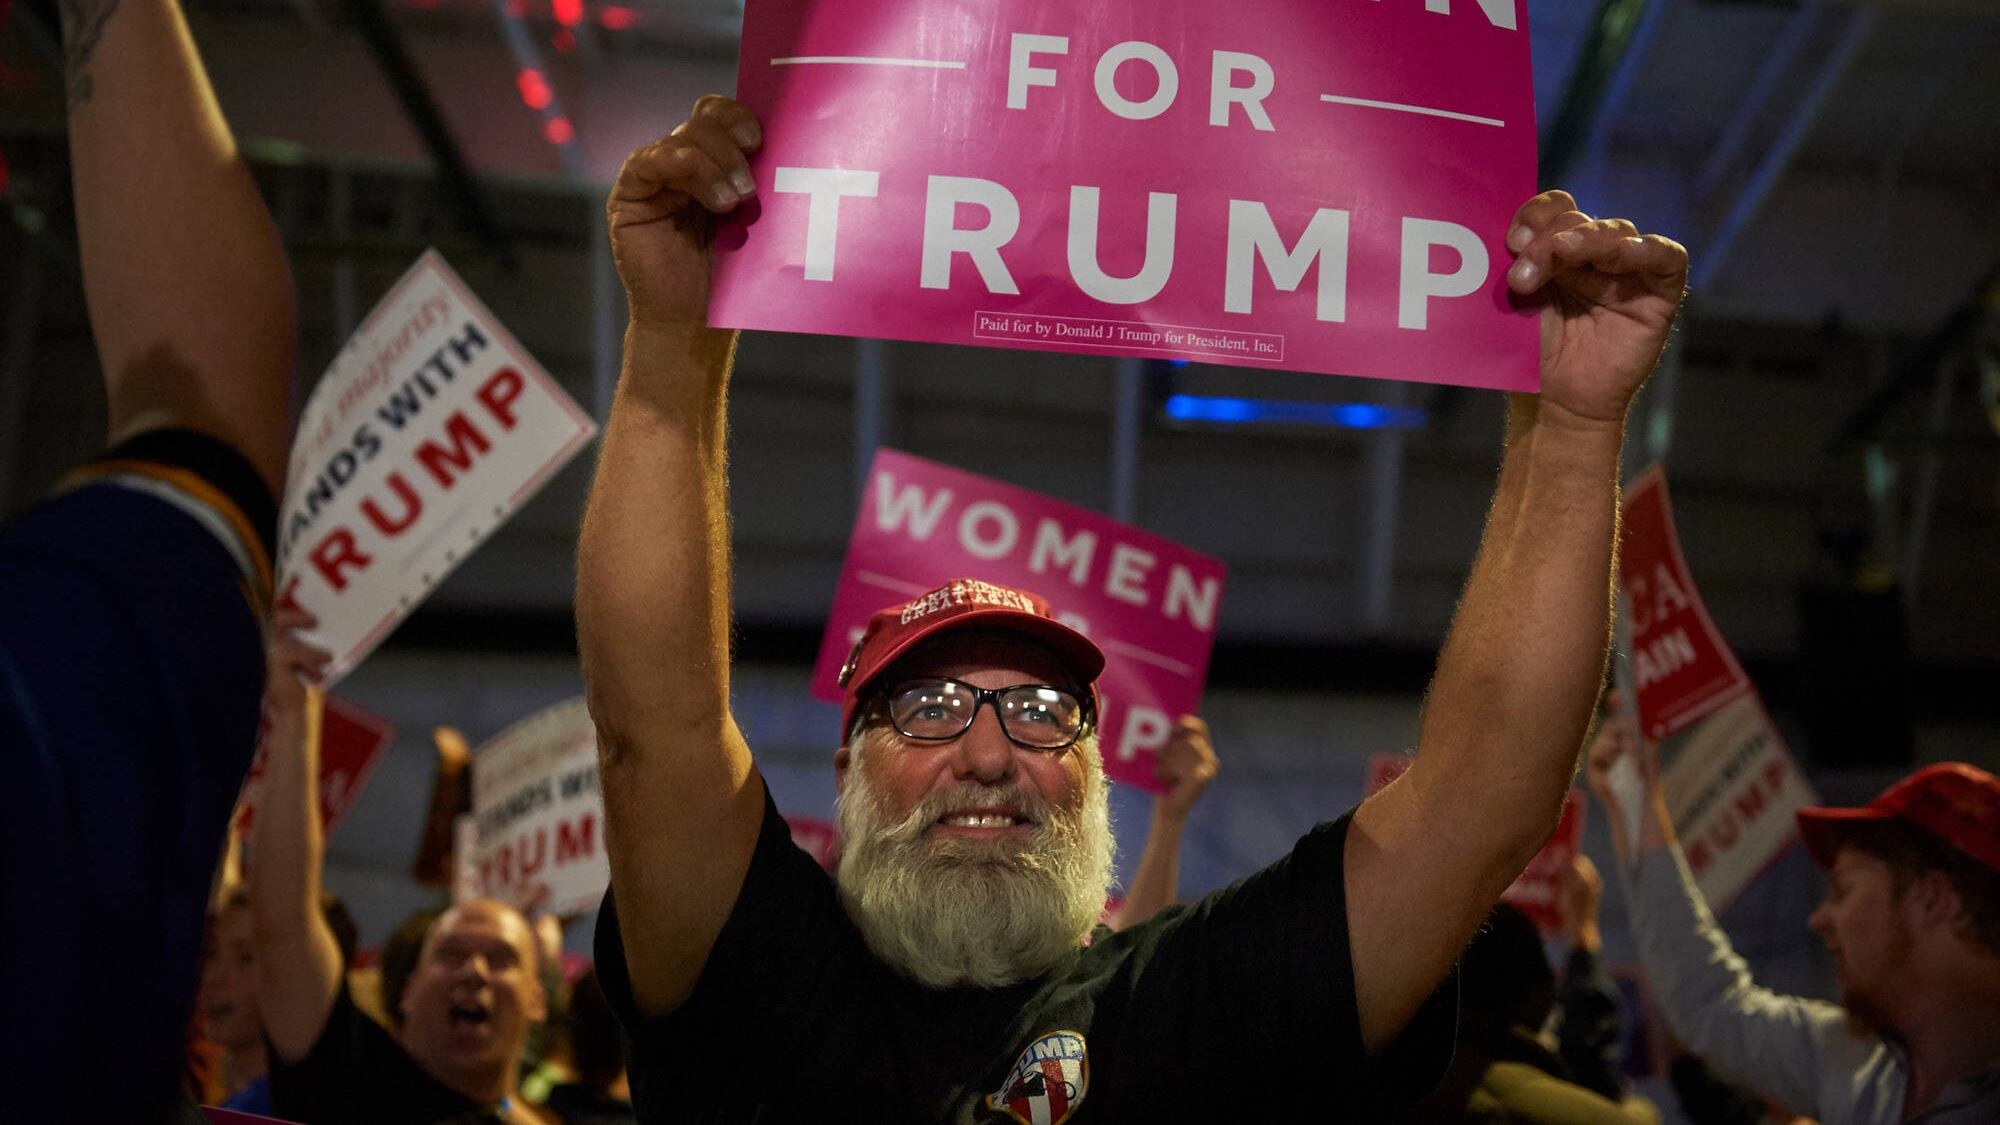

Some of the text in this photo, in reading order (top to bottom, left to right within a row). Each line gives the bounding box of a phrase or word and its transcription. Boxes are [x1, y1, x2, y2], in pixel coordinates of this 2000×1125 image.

[1007, 33, 1276, 132] FOR
[774, 167, 1490, 330] TRUMP
[377, 320, 489, 430] WITH
[980, 317, 1279, 354] Paid for by Donald J Trump for President, Inc.
[876, 472, 1219, 630] WOMEN
